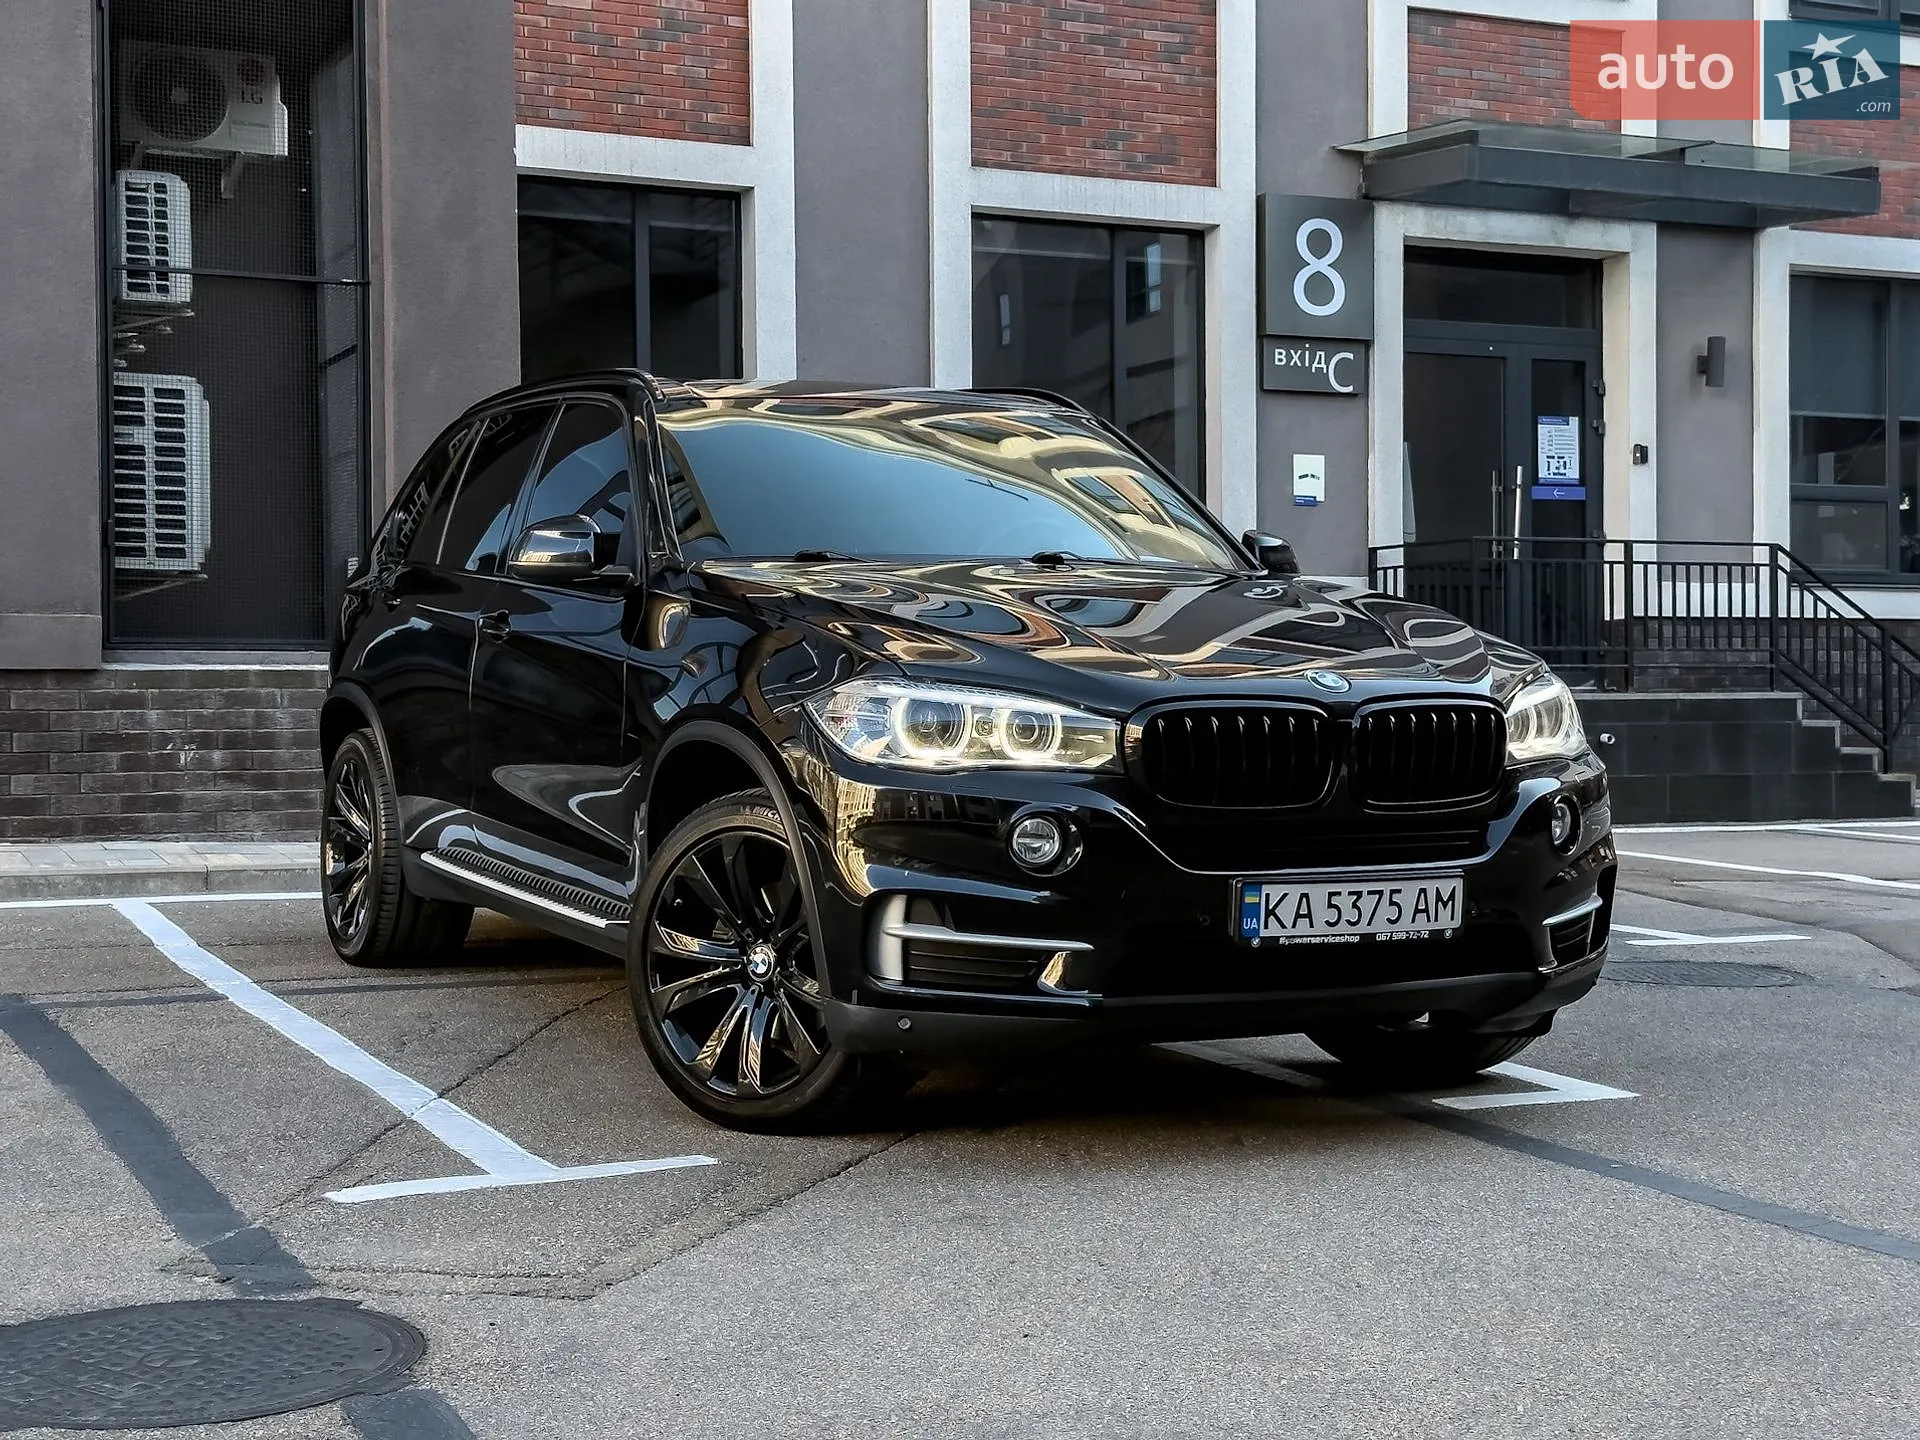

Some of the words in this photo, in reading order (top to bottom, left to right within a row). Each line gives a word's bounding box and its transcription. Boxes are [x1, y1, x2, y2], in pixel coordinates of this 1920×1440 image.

[1293, 217, 1346, 316] 8
[1274, 343, 1327, 374] вхід
[1263, 891, 1315, 930] KA
[1324, 888, 1403, 928] 5375
[1410, 885, 1457, 924] AM
[1243, 917, 1258, 930] UA
[1376, 932, 1391, 941] 067
